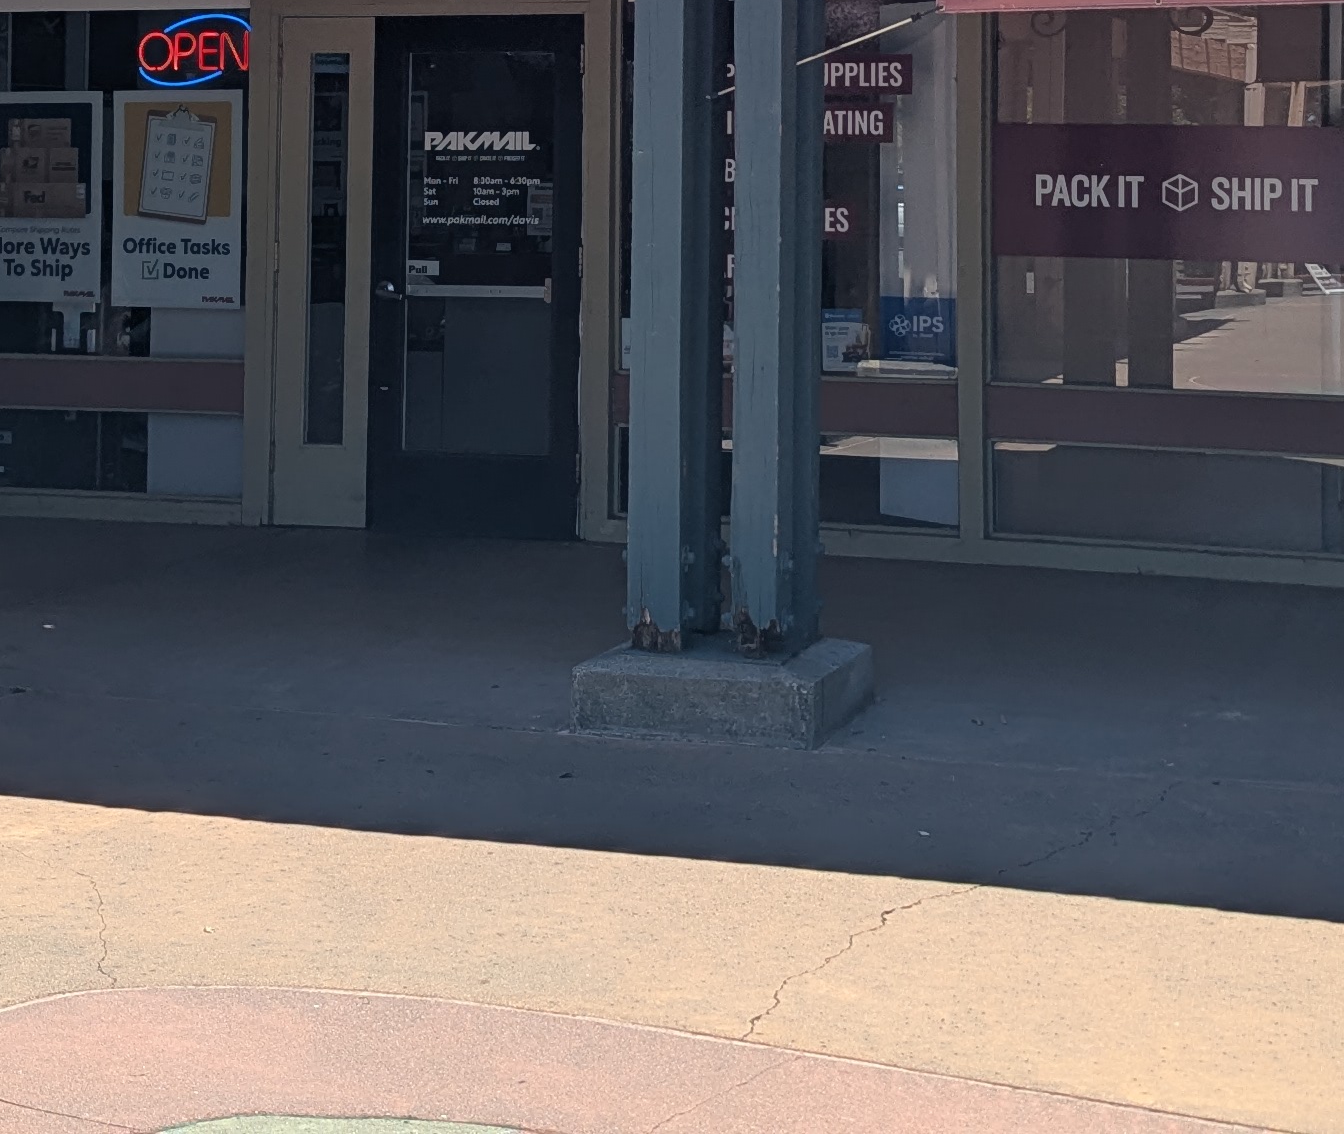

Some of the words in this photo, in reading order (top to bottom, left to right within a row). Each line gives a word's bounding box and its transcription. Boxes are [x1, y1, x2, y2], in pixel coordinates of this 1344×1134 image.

[137, 30, 250, 72] OPEN
[824, 110, 884, 135] ATING
[424, 131, 536, 151] PAKMAIL
[424, 176, 441, 185] Mon
[449, 176, 459, 185] Fri
[424, 187, 437, 196] Sat
[473, 187, 495, 196] 10am
[502, 187, 519, 197] 3pm
[1035, 173, 1110, 208] PACK
[1118, 175, 1144, 208] IT
[1211, 177, 1282, 211] SHIP
[1291, 178, 1319, 212] IT
[424, 197, 439, 206] Sun
[473, 197, 500, 206] Closed
[422, 215, 539, 226] www.pakmail.com/davis
[40, 237, 91, 259] Ways
[122, 237, 177, 255] Office
[180, 238, 231, 256] Tasks
[3, 259, 25, 276] To
[30, 259, 74, 281] Ship
[163, 262, 210, 280] Done
[912, 315, 945, 333] IPS
